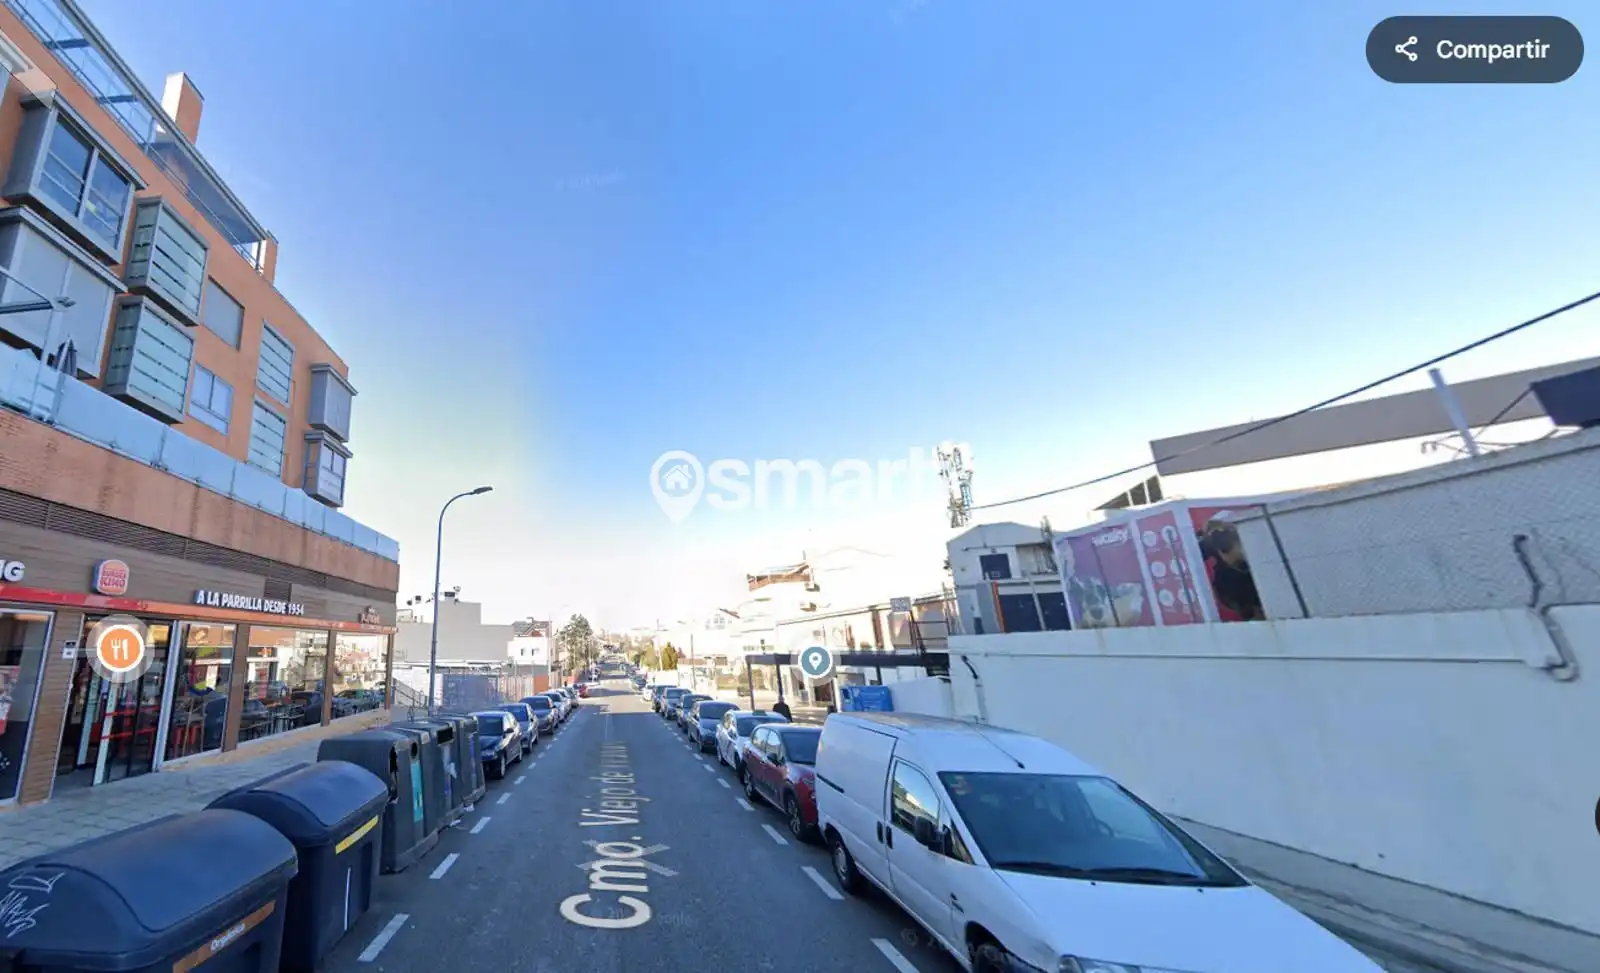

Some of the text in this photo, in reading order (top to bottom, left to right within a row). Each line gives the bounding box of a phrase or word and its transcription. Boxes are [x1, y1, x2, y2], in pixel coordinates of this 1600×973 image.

[0, 559, 26, 582] G
[196, 590, 305, 615] A LA PARRILLA DESDE 1954
